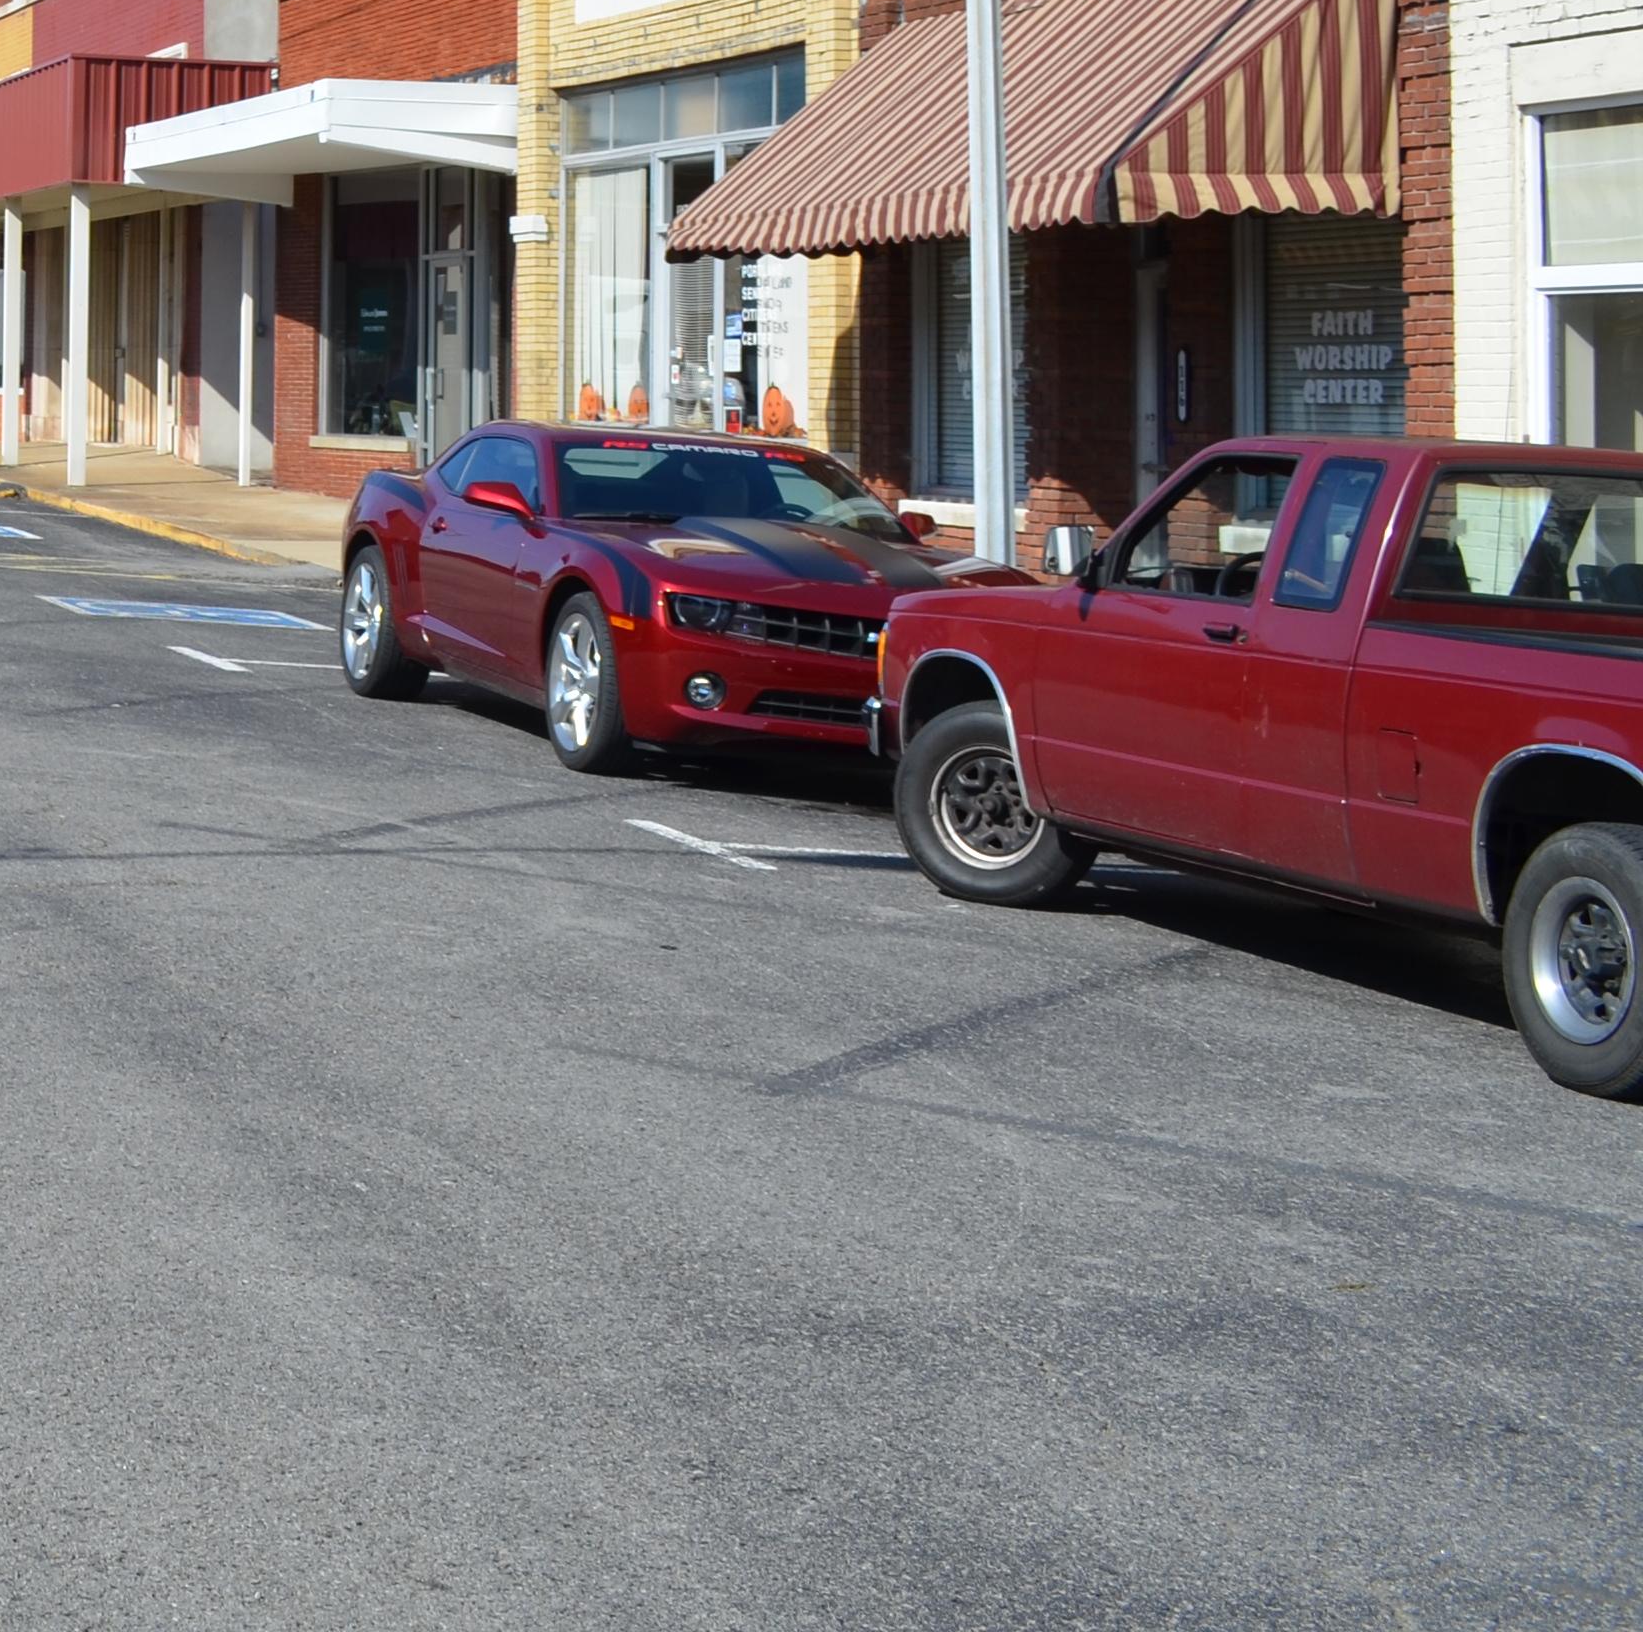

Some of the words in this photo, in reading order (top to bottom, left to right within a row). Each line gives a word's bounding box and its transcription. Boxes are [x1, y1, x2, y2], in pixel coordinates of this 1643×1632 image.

[1311, 309, 1374, 336] FAITH
[1295, 344, 1393, 370] WORSHIP
[1303, 378, 1384, 404] CENTER
[651, 442, 759, 458] CAMARO
